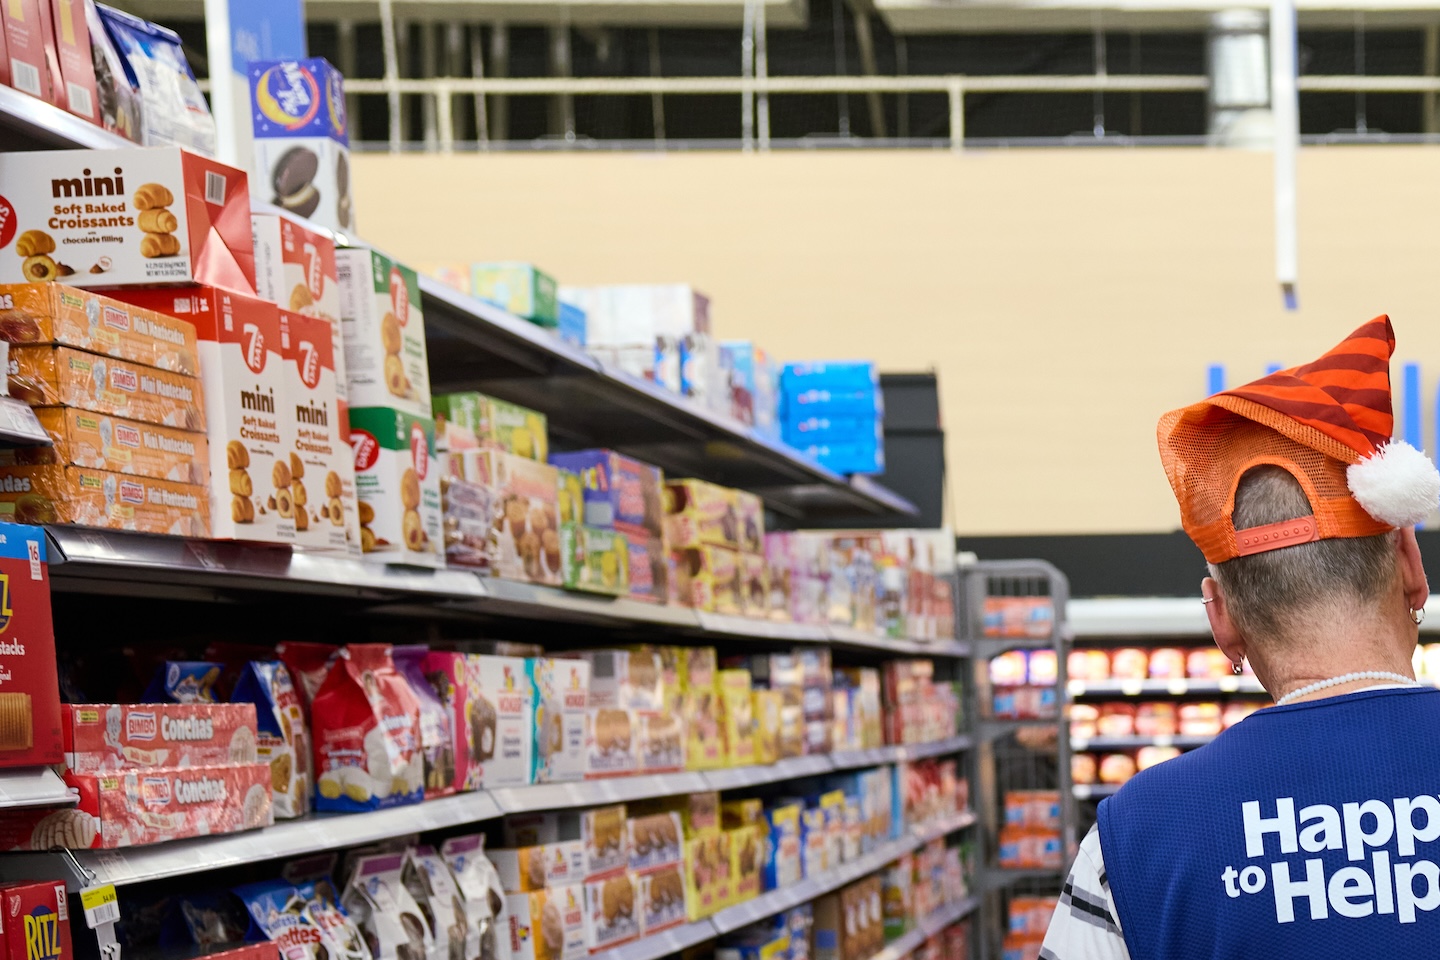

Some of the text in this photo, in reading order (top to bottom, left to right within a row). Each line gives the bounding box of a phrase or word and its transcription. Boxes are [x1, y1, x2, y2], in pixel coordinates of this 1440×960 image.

[51, 167, 125, 198] mini
[54, 202, 126, 215] Soft Baked
[48, 215, 134, 229] Croissants
[62, 235, 124, 245] chocolate filling
[105, 309, 129, 328] BIMBO
[241, 385, 275, 414] mini
[296, 402, 328, 427] mini
[257, 418, 276, 430] Baked
[117, 430, 139, 444] BIMBO
[240, 427, 280, 444] Croissants
[296, 439, 333, 455] Croissants
[121, 485, 144, 501] BIMBO
[129, 719, 155, 735] BIMBO
[161, 714, 213, 741] Conchas
[175, 776, 226, 804] Conchas
[1221, 865, 1267, 898] to
